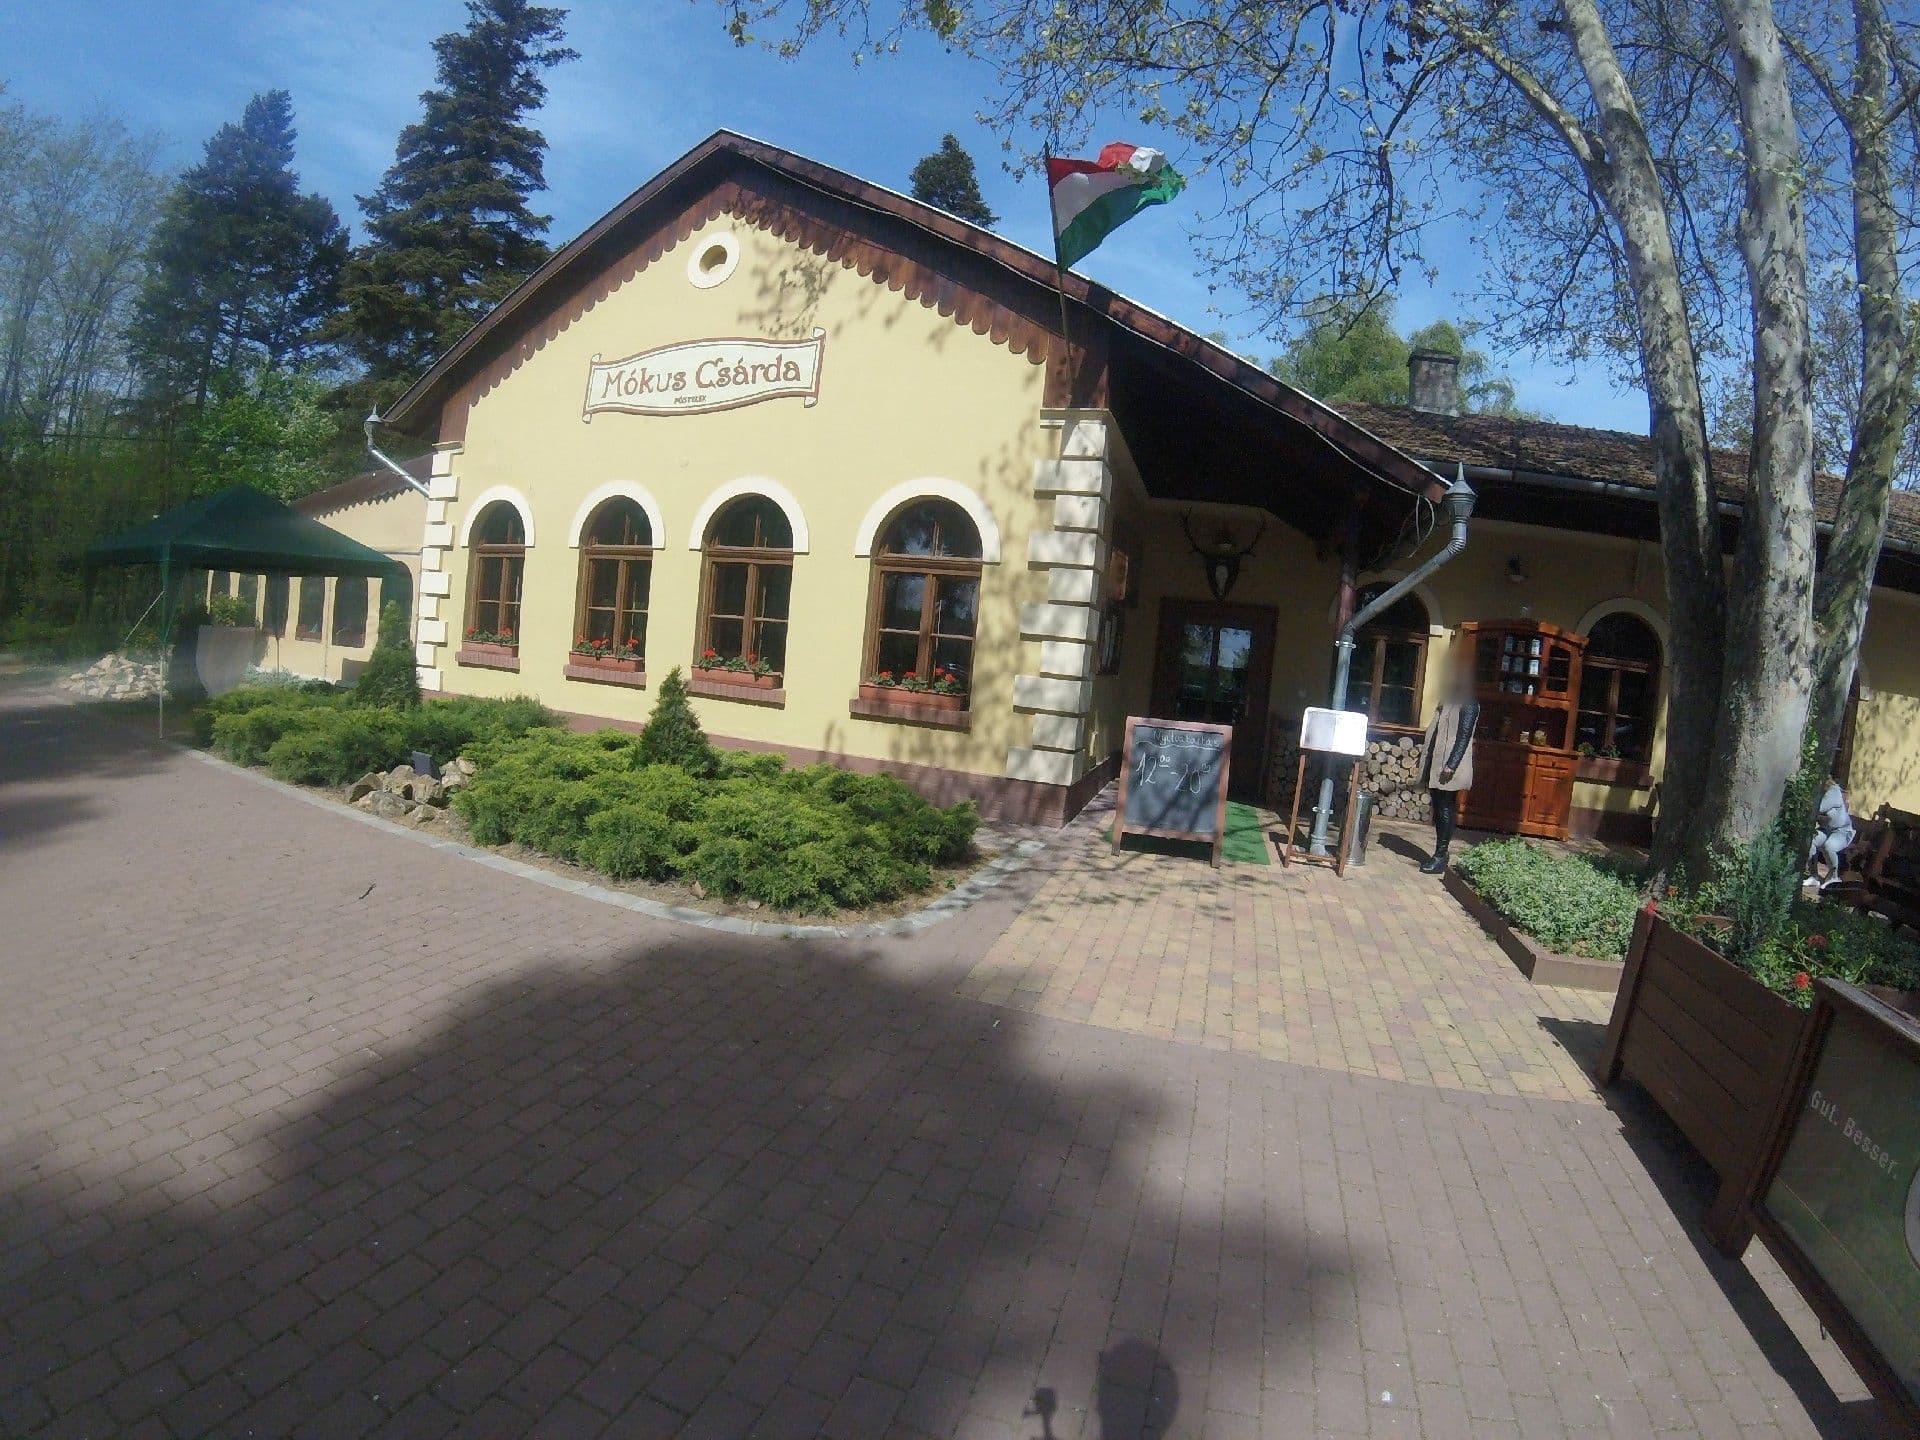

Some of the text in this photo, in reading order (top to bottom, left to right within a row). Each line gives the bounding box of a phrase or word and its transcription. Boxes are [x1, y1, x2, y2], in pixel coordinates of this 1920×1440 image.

[601, 355, 801, 399] Mókus Csárda
[1811, 1090, 1898, 1180] Gut. Besser.
